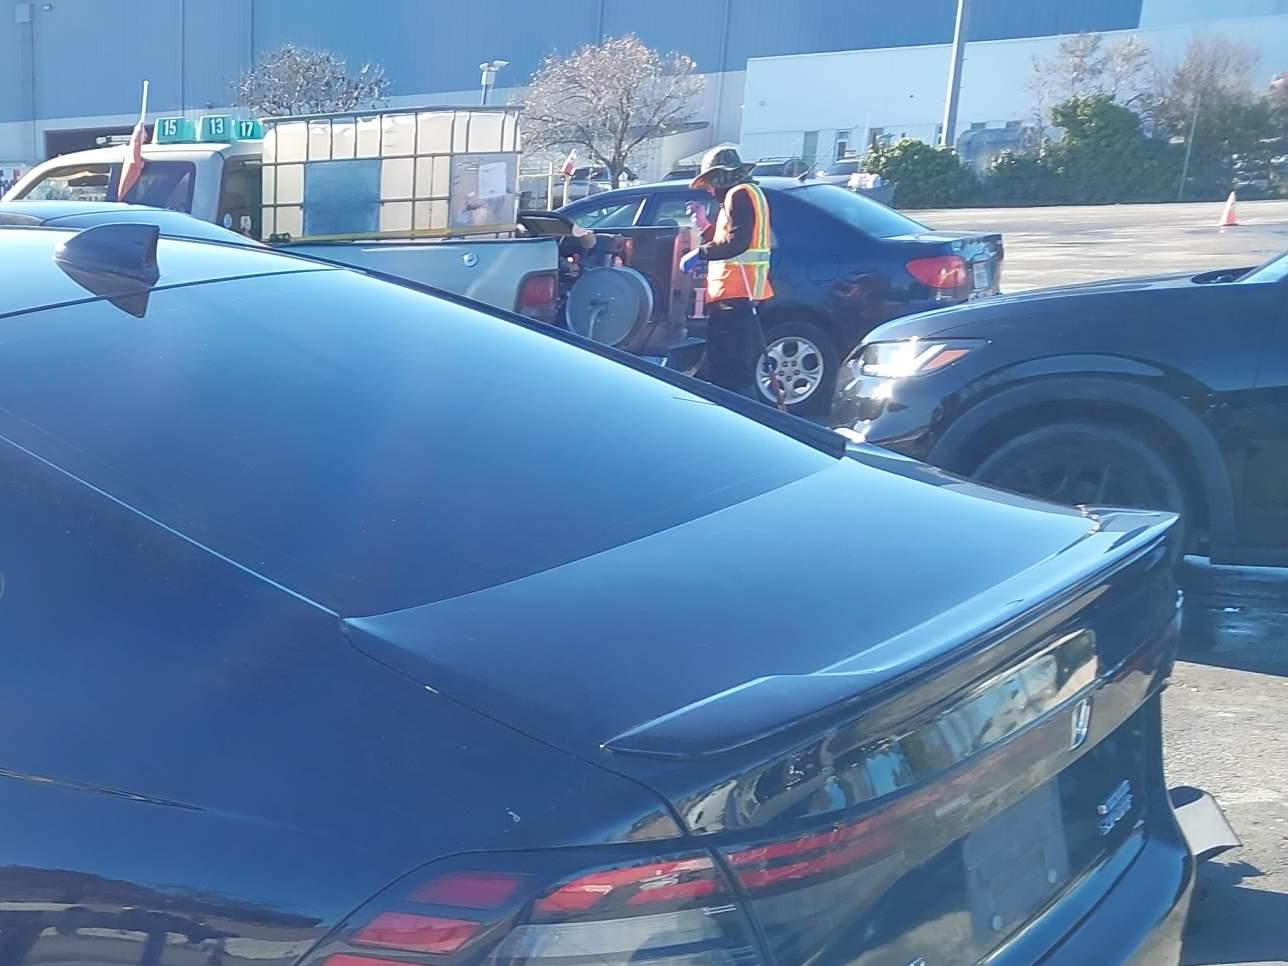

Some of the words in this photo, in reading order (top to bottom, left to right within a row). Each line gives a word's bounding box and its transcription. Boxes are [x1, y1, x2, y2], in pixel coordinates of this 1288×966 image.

[164, 119, 177, 136] 15
[210, 117, 224, 135] 13
[240, 121, 254, 137] 17
